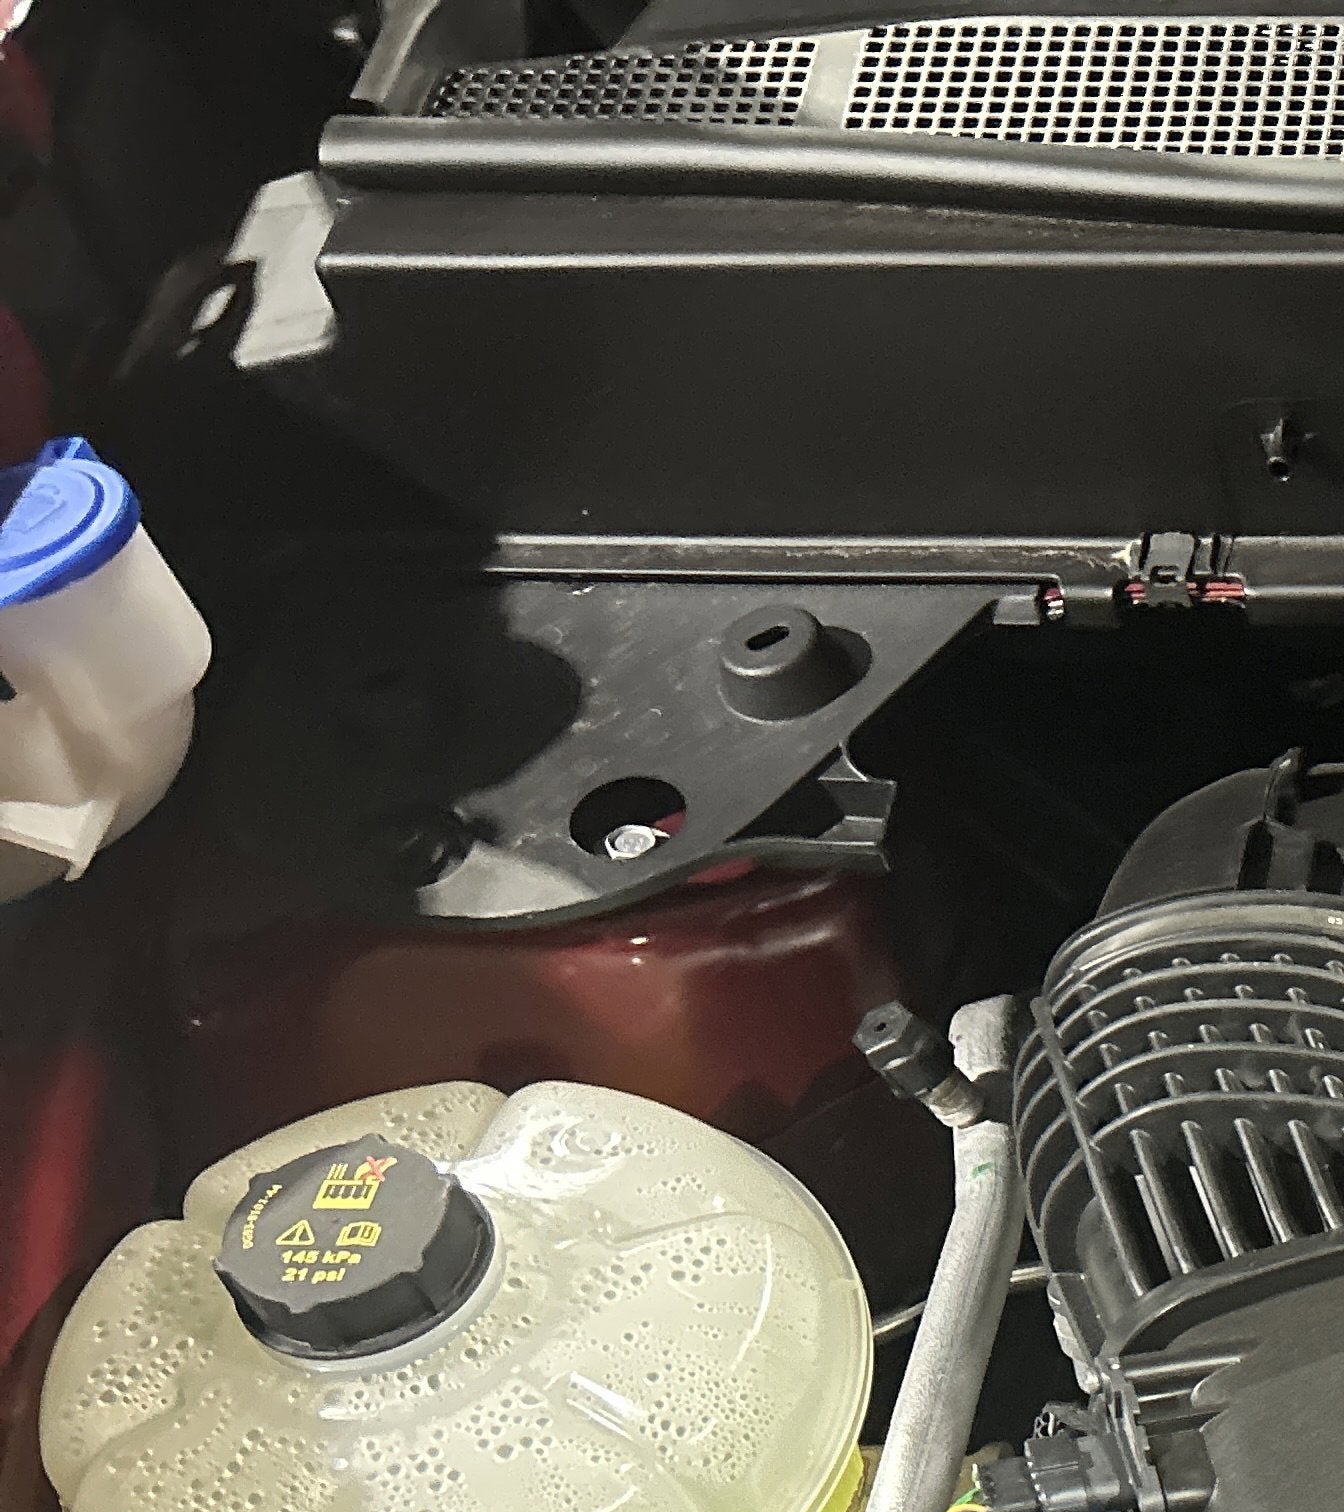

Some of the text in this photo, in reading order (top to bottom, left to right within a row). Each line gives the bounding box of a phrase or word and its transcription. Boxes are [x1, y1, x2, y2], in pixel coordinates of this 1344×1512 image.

[281, 1250, 361, 1265] 145 kPa
[281, 1267, 346, 1285] 21 psi
